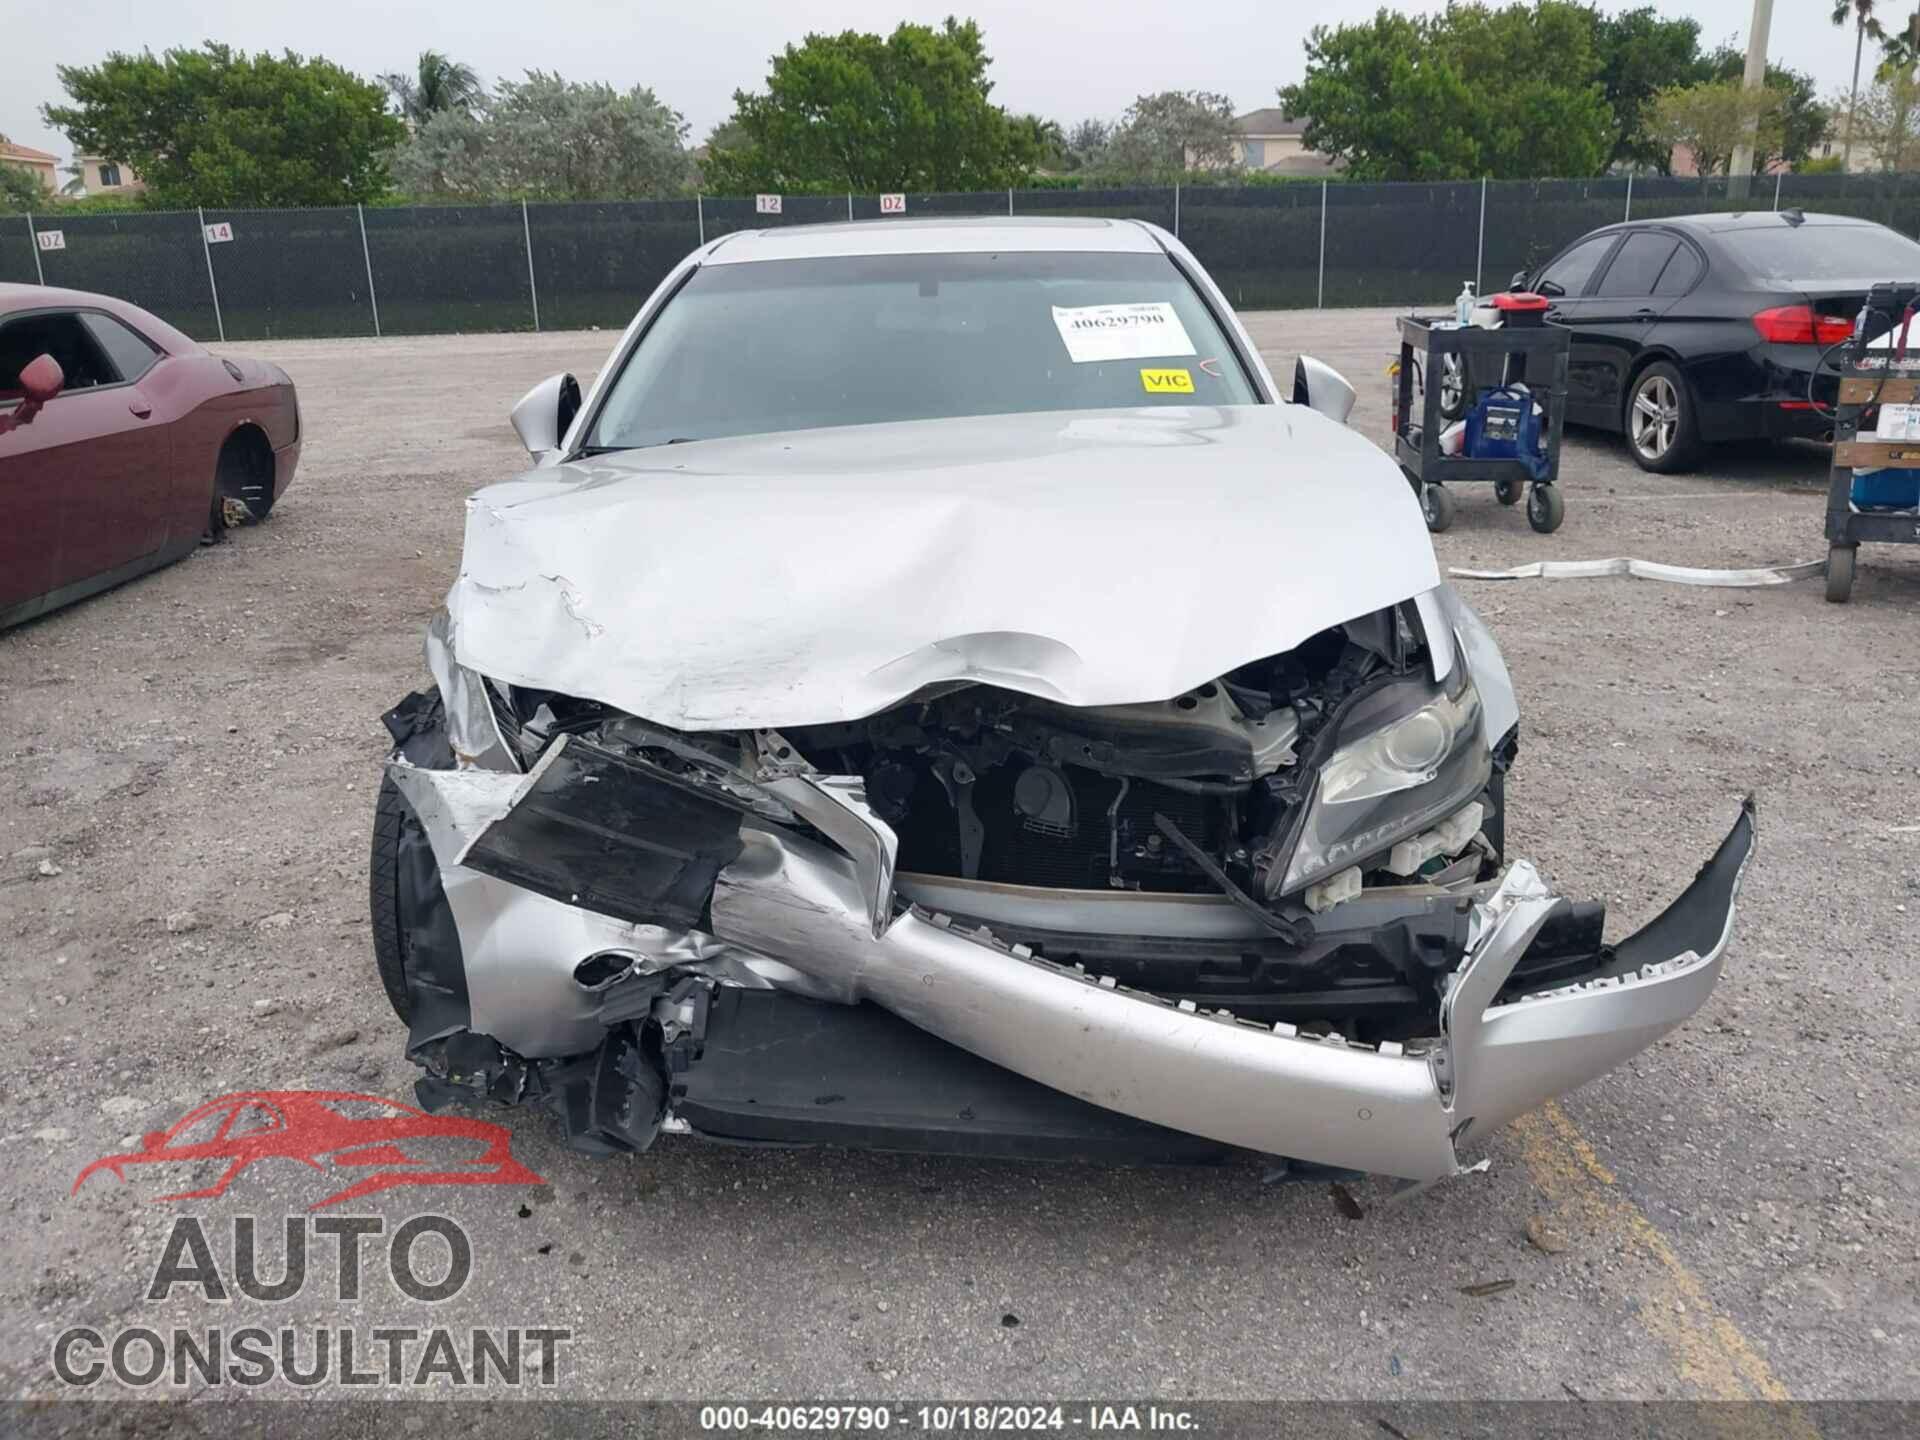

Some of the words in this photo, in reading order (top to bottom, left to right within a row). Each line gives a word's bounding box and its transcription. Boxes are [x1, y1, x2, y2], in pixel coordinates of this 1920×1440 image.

[760, 197, 778, 211] 12
[209, 226, 229, 240] 14
[1070, 312, 1165, 330] 40629790
[1146, 374, 1188, 387] VIC
